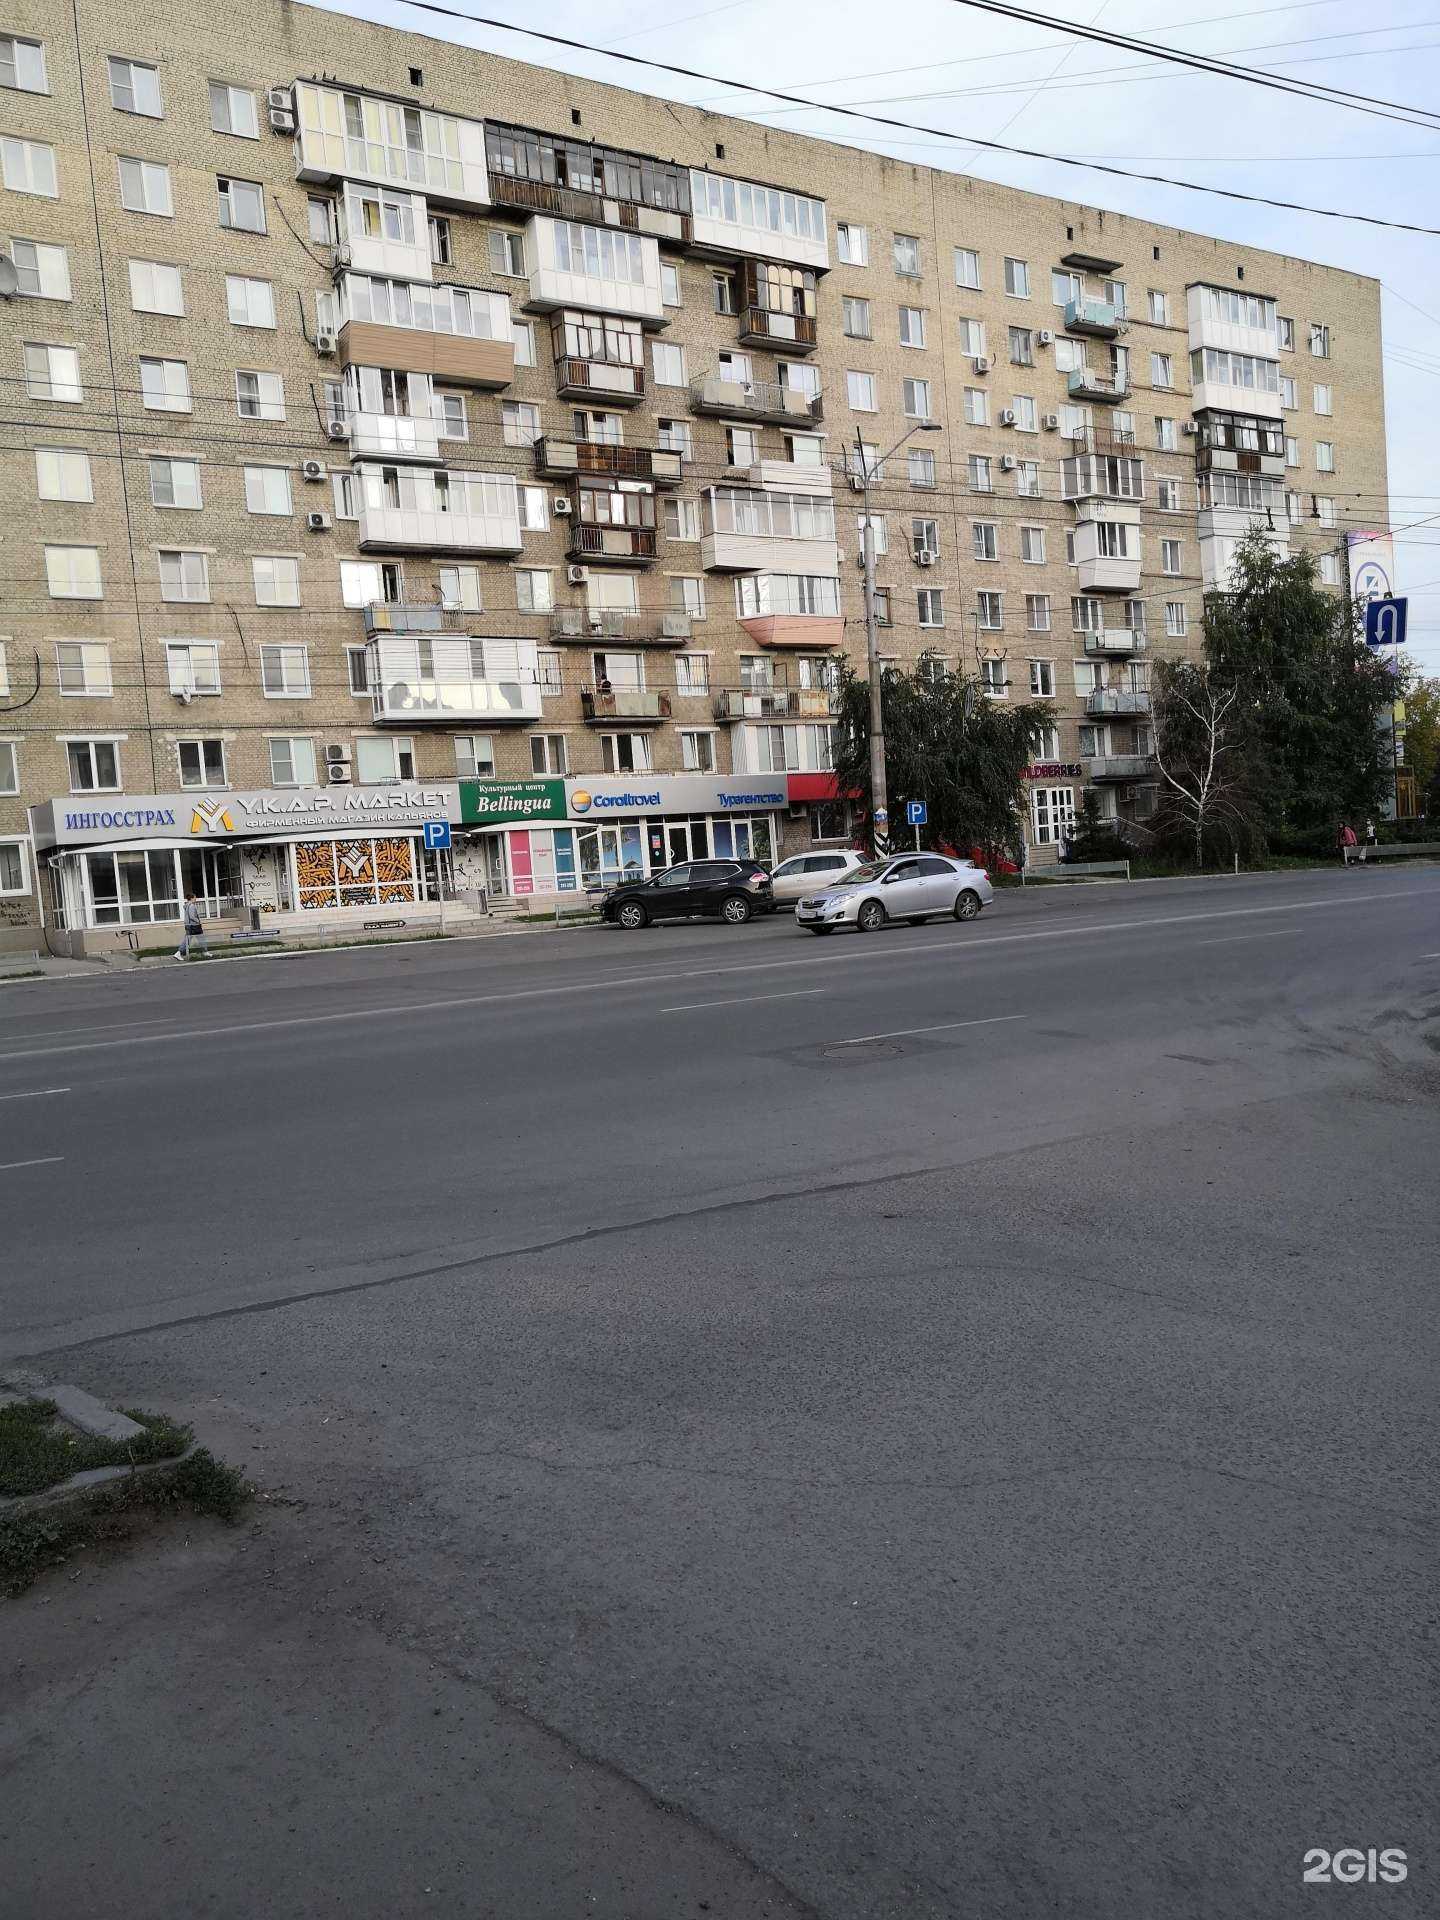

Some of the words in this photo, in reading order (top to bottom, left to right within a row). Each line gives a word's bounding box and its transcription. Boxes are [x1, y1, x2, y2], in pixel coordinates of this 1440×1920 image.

[479, 784, 523, 794] Культурный
[525, 784, 546, 792] центр
[343, 790, 452, 811] MARKET
[476, 795, 552, 814] Bellingua
[717, 793, 784, 808] Турагентство
[65, 809, 176, 830] ИНГОССТРАХ
[247, 816, 325, 828] ФИРМЕННЫЙ
[328, 813, 385, 825] МАГАЗИН
[387, 810, 449, 821] КАЛЬЯНОВ
